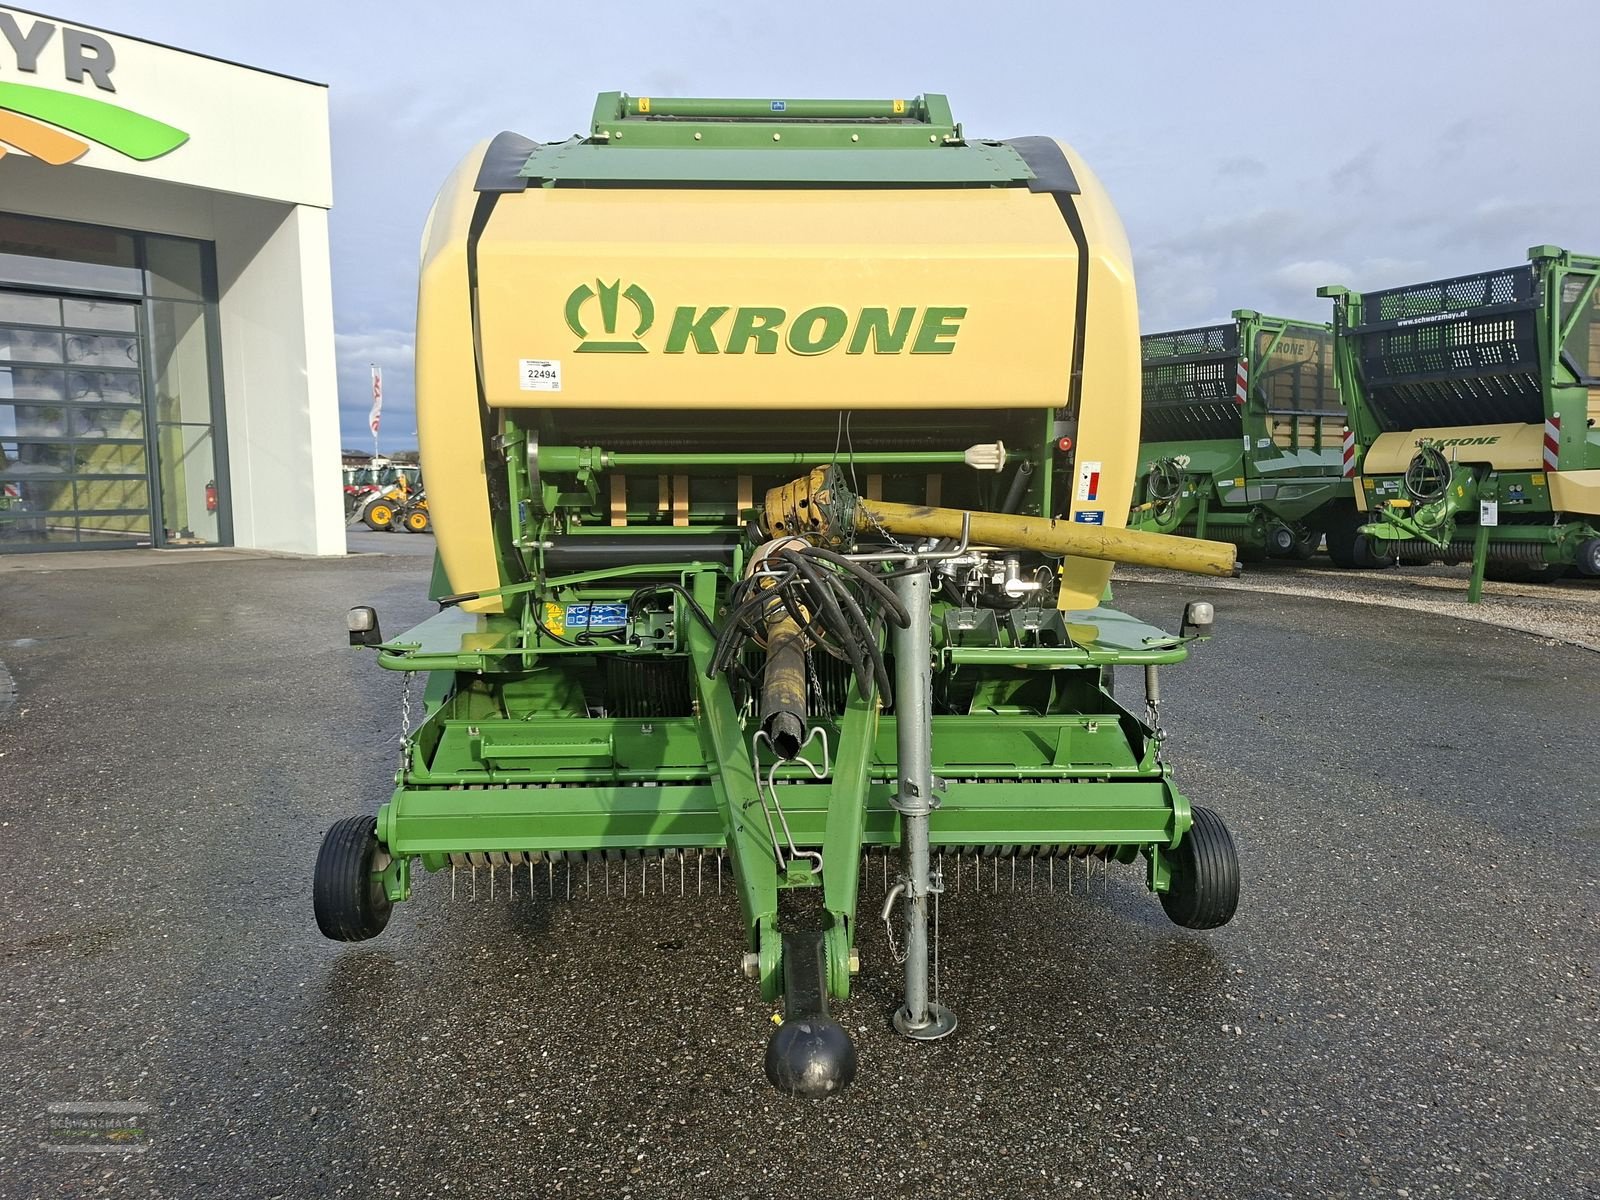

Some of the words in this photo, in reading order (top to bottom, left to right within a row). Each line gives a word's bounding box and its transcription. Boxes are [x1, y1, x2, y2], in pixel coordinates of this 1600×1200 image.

[0, 12, 117, 94] YR
[663, 304, 968, 356] KRONE
[1274, 342, 1305, 355] RONE
[528, 369, 557, 379] 22494
